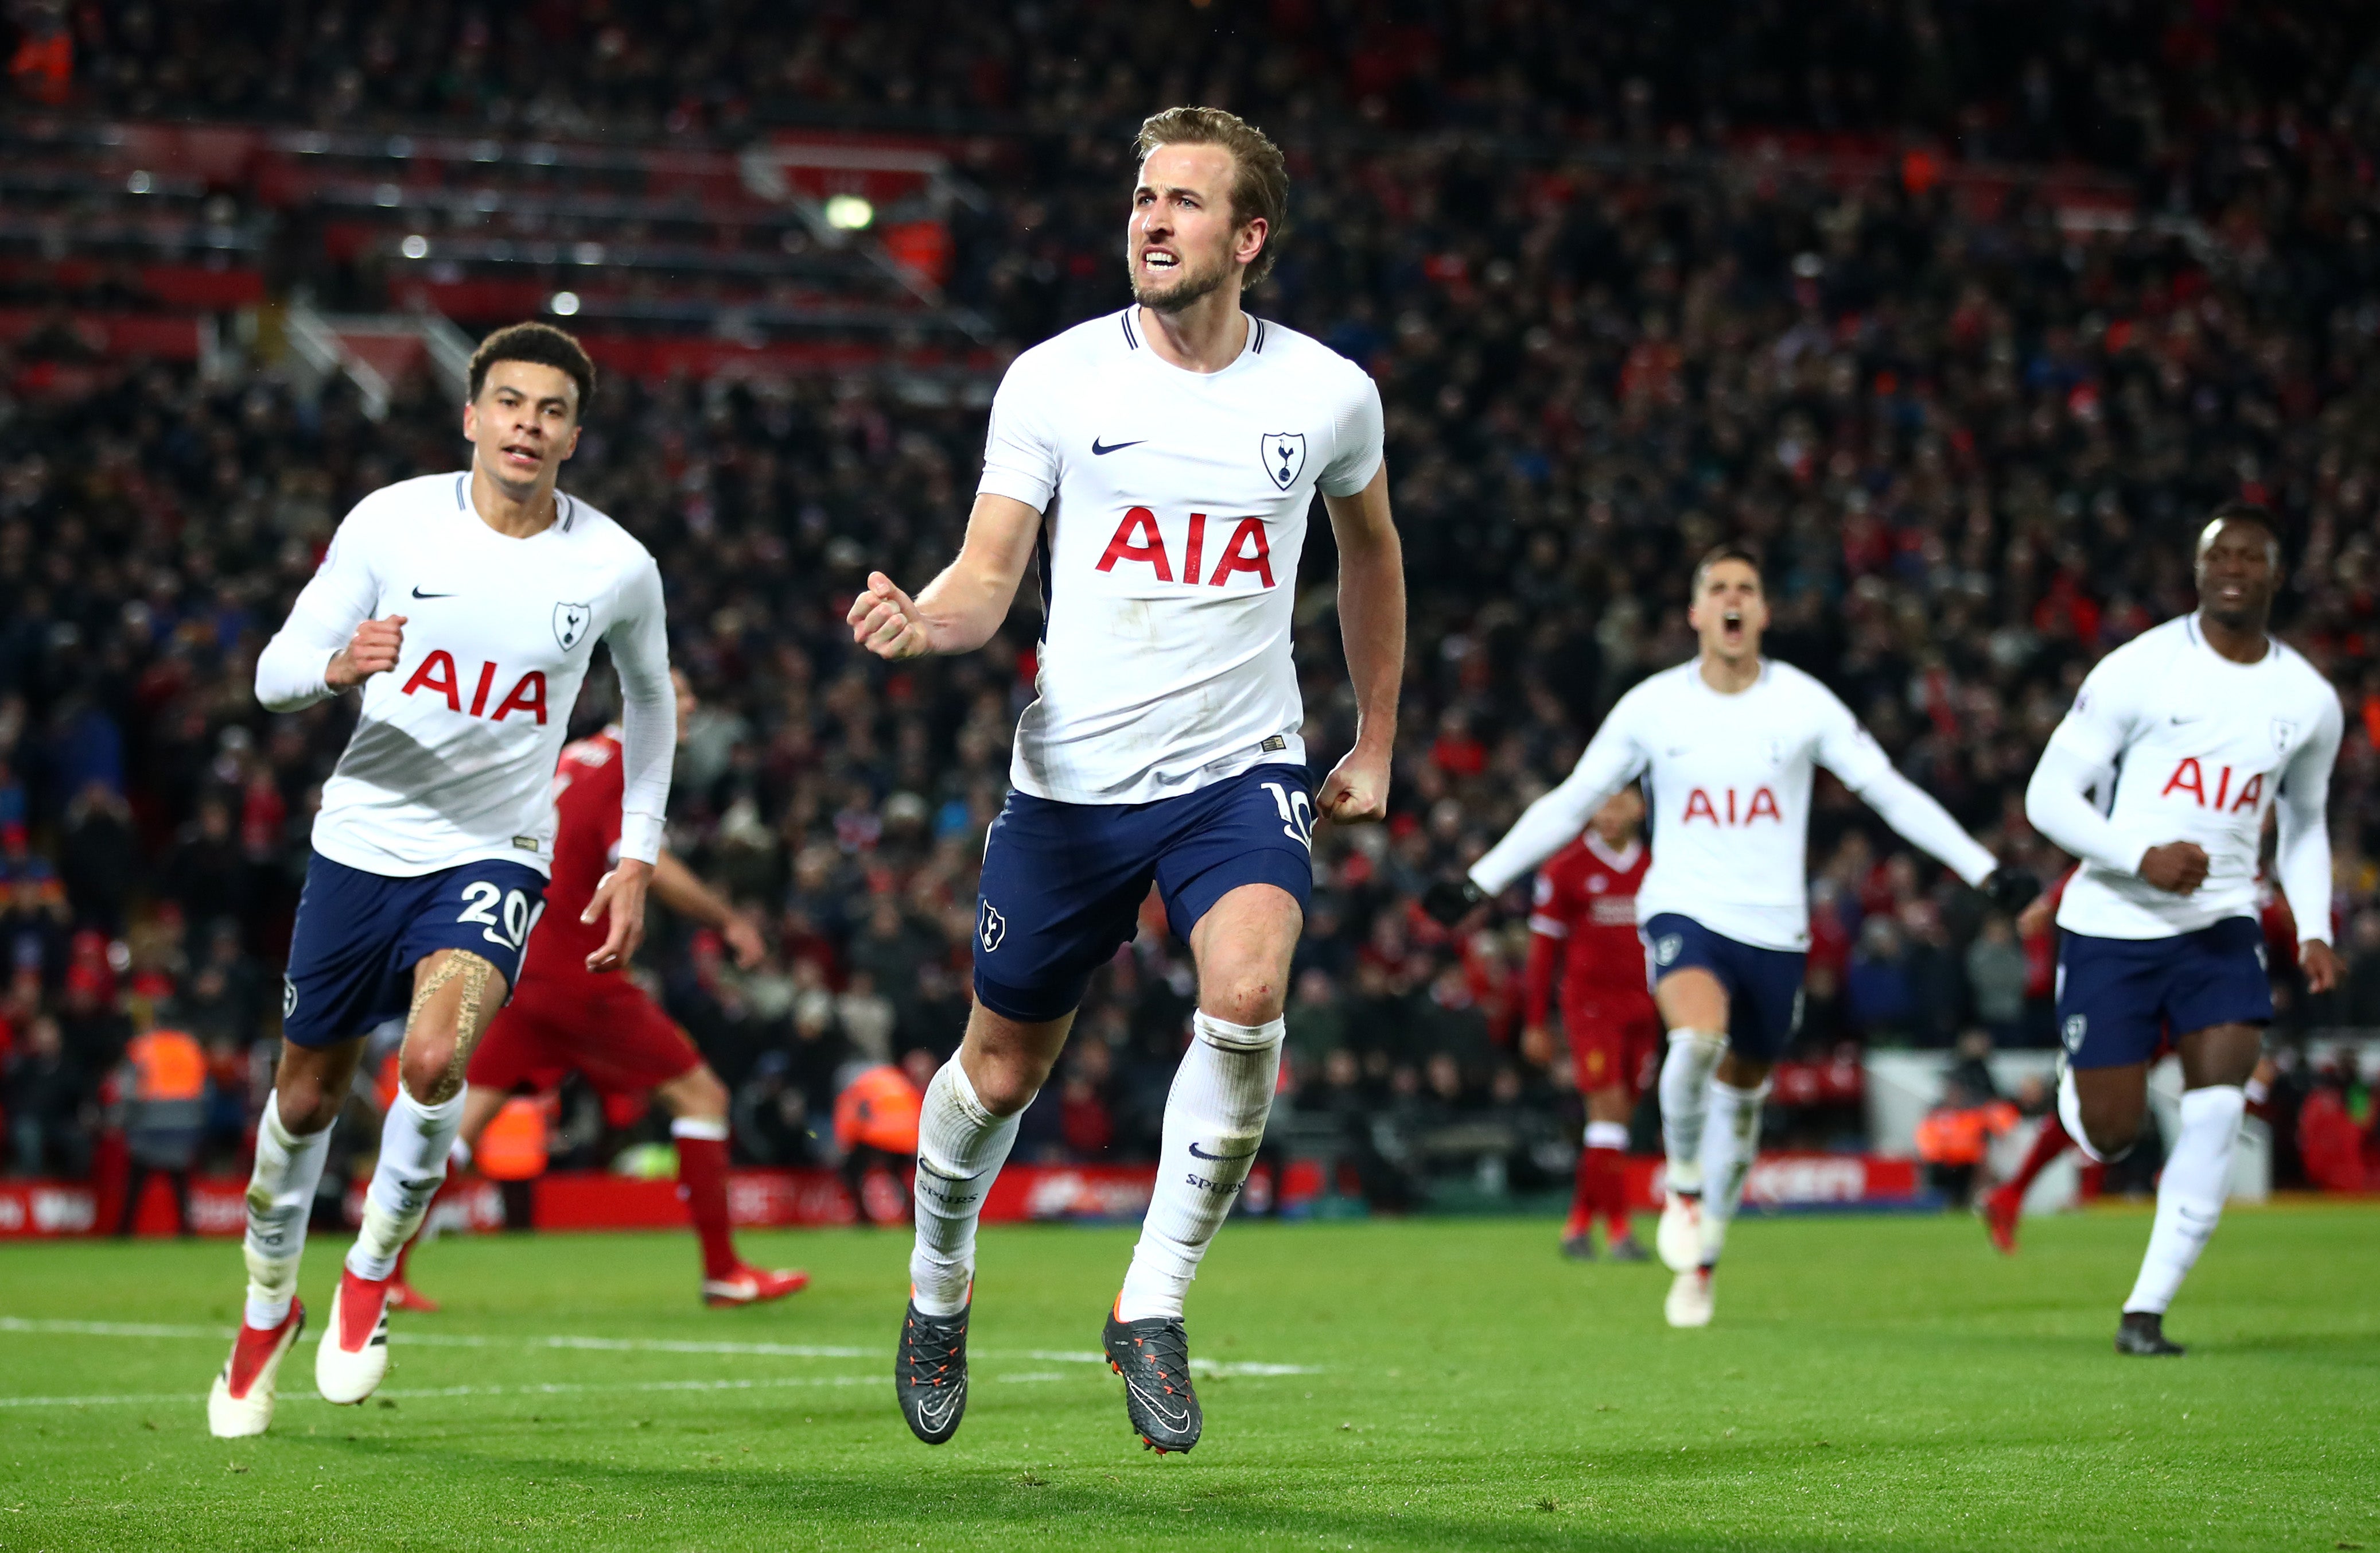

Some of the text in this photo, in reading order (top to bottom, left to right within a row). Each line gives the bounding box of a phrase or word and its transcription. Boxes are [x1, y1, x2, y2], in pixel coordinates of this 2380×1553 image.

[1095, 506, 1275, 589] AIA
[401, 649, 547, 725] AIA
[1261, 782, 1313, 841] 10
[1682, 788, 1782, 826] AIA
[2163, 757, 2263, 813] AIA
[456, 880, 528, 947] 20
[919, 1179, 978, 1205] SPURS
[1185, 1173, 1245, 1194] SPURS
